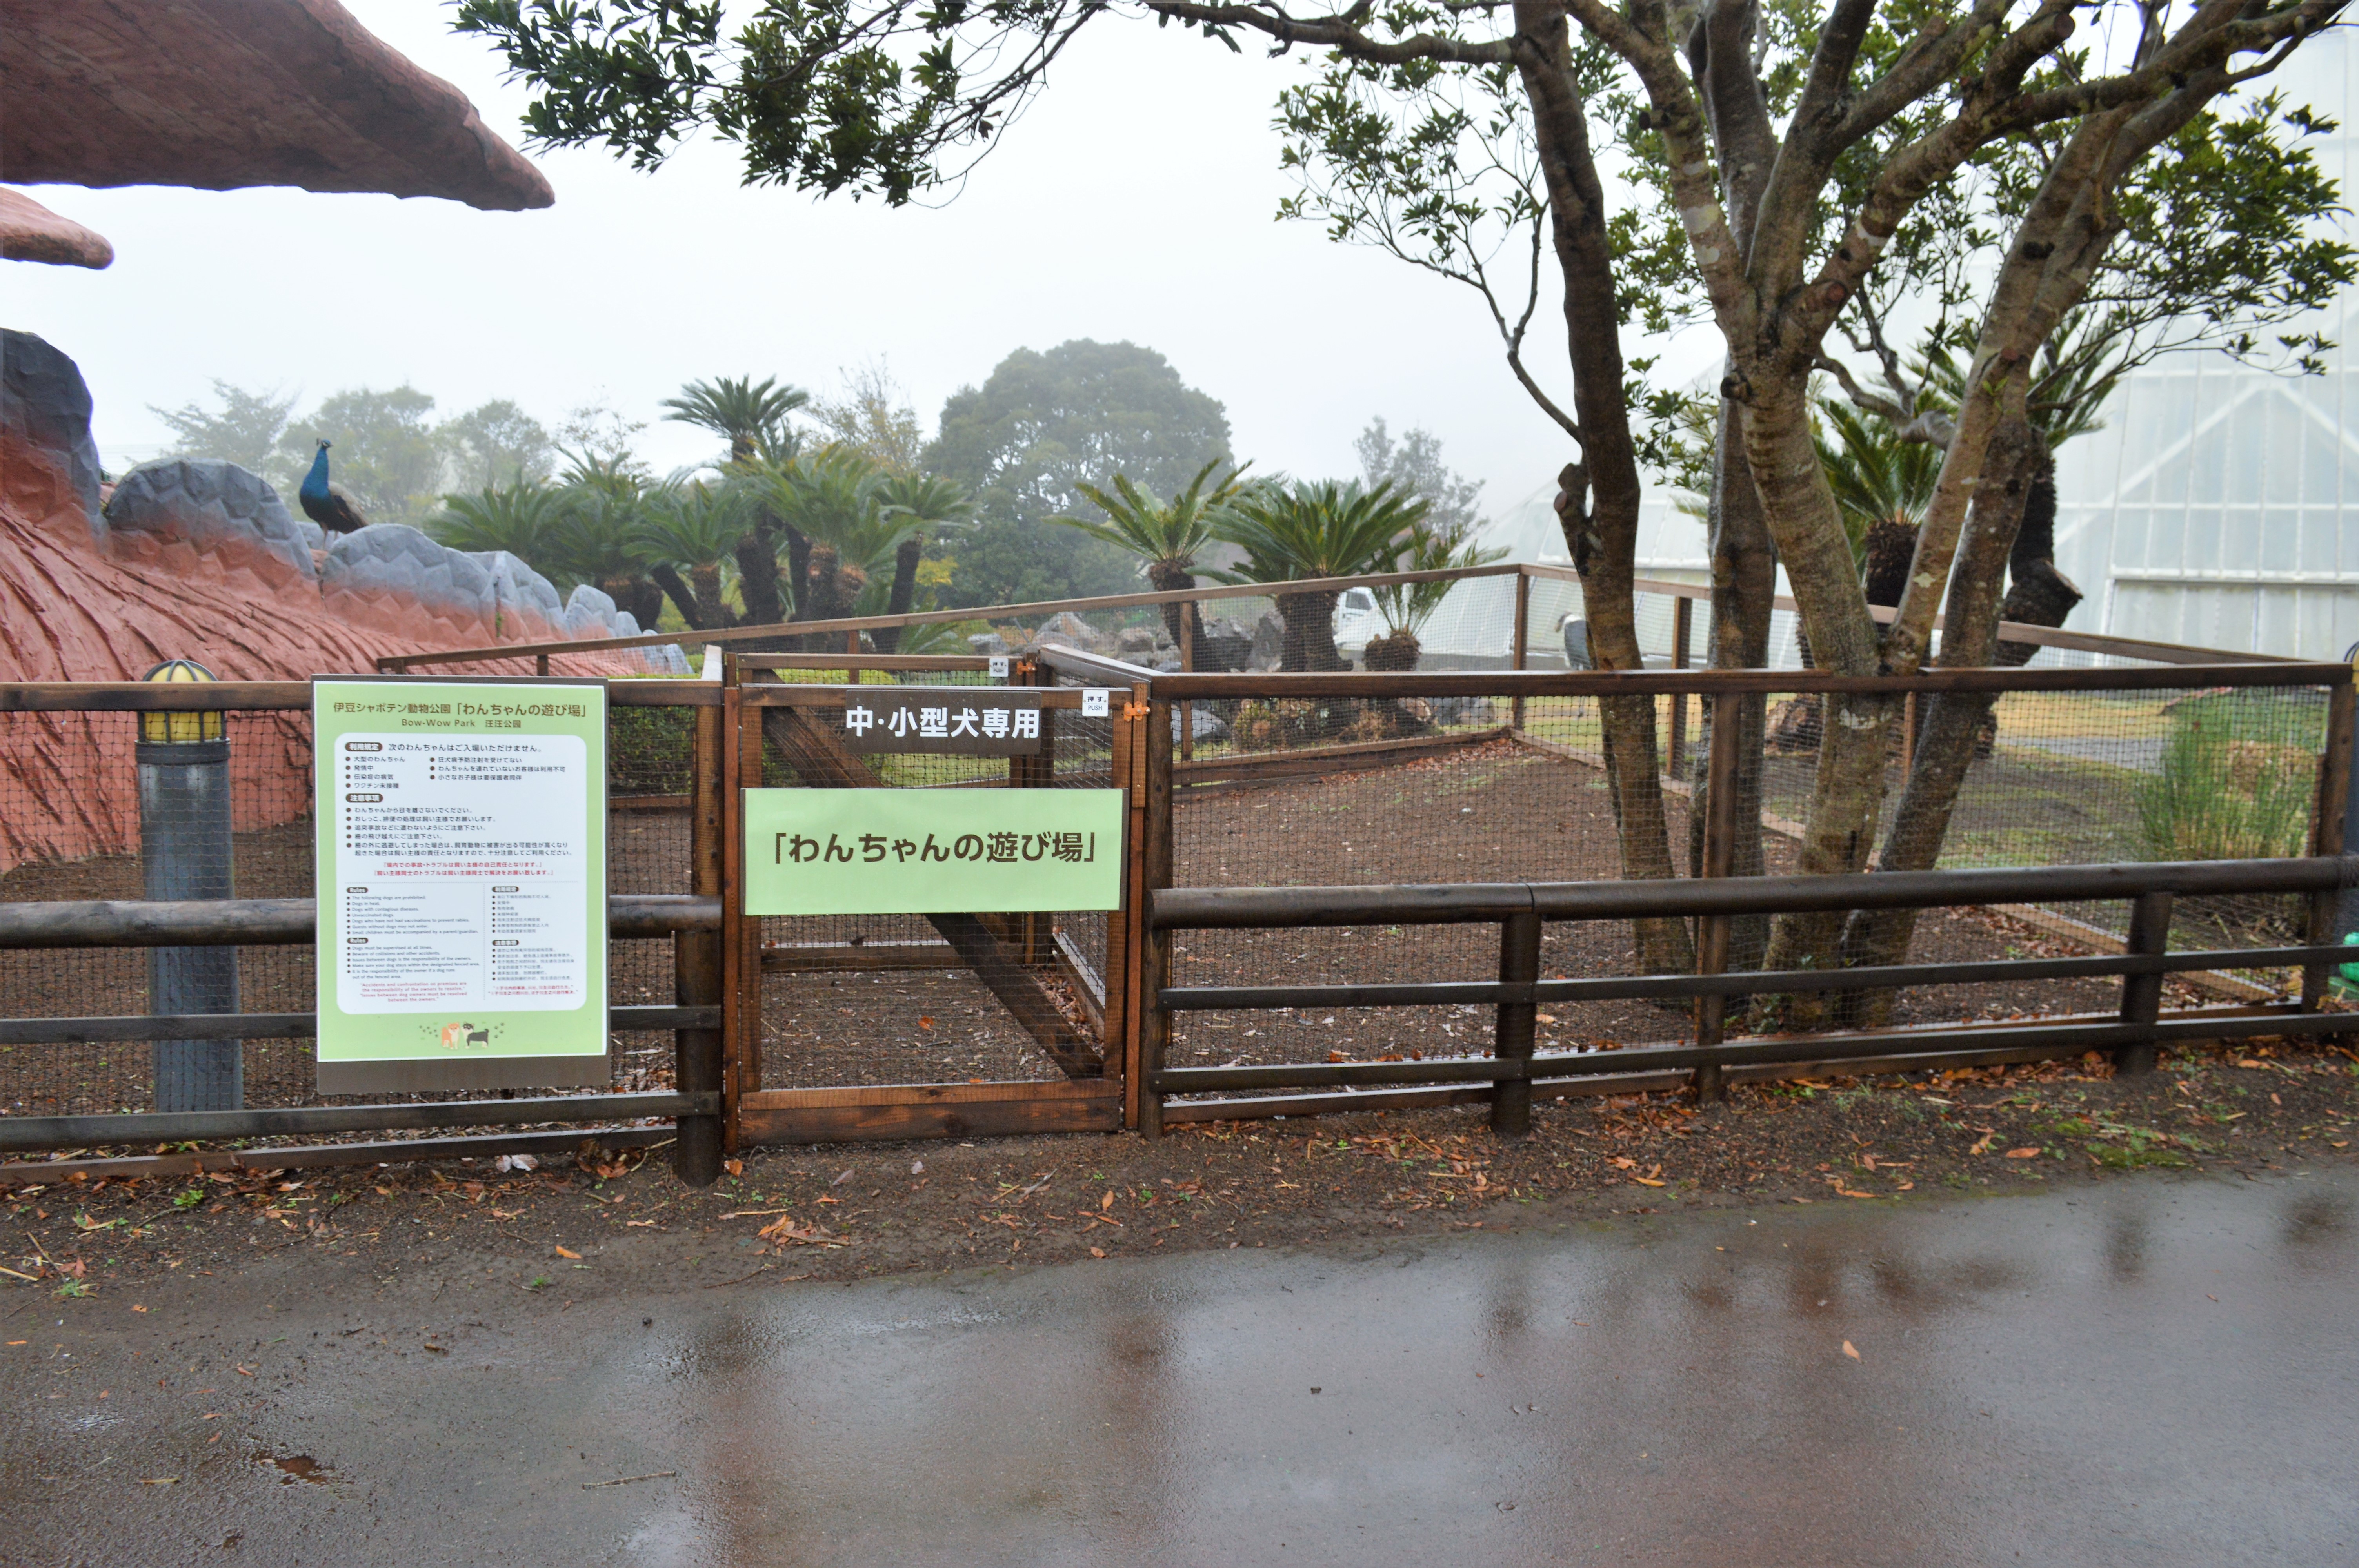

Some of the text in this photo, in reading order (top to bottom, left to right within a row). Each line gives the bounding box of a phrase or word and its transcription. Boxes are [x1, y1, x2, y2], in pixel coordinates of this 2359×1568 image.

[389, 744, 542, 752] 次のわんちゃんはご入場いただけません。
[775, 831, 1095, 864] 「わんちゃんの遊び場」
